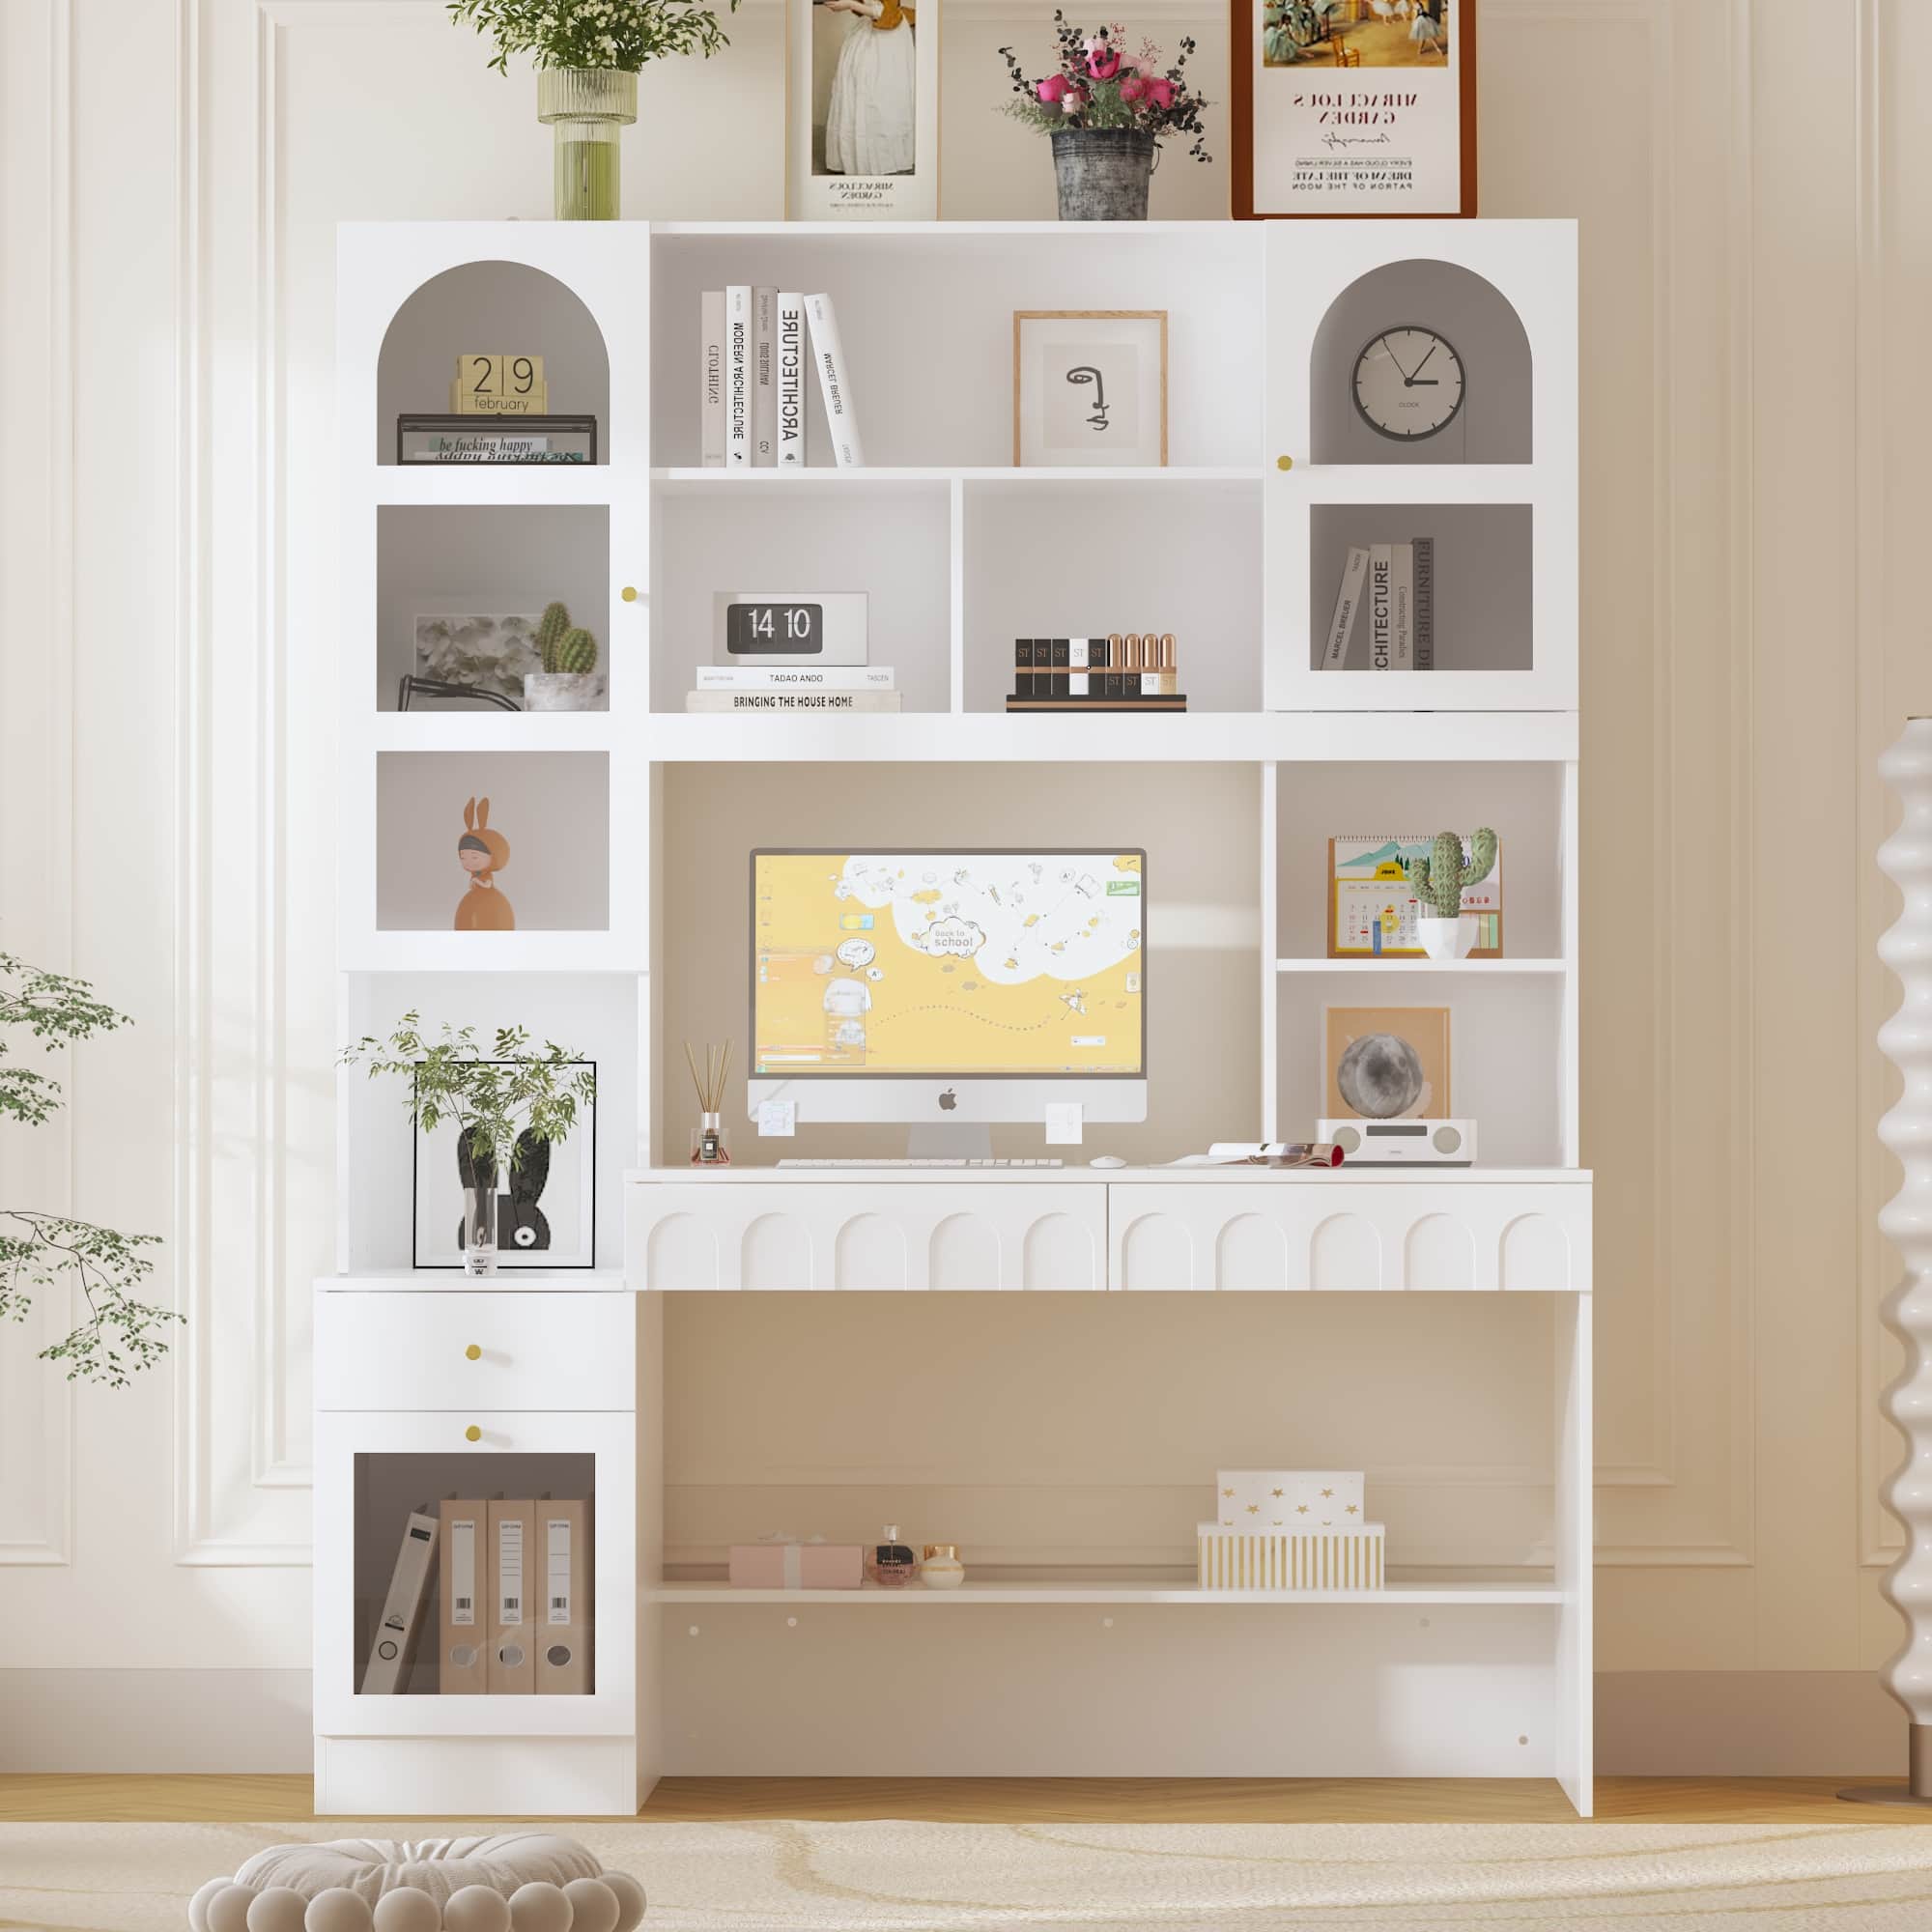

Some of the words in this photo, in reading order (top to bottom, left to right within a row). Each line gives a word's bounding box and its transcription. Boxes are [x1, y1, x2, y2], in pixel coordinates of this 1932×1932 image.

[474, 395, 529, 412] february
[440, 437, 452, 453] be
[454, 437, 497, 455] fucking
[499, 437, 533, 453] happy
[1417, 541, 1431, 644] FURNITURE
[1375, 561, 1388, 670] CHITECTURE
[749, 608, 775, 639] 14
[783, 608, 811, 639] 10
[1331, 630, 1345, 660] MARCEL
[1018, 648, 1030, 658] ST
[1037, 648, 1047, 658] ST
[1054, 648, 1065, 658] ST
[1073, 648, 1084, 658] ST
[1091, 648, 1102, 658] ST
[1145, 676, 1156, 686] ST
[734, 696, 776, 707] BRINGING
[779, 696, 795, 707] THE
[798, 696, 826, 707] HOUSE
[829, 696, 853, 707] HOME
[934, 937, 973, 948] school
